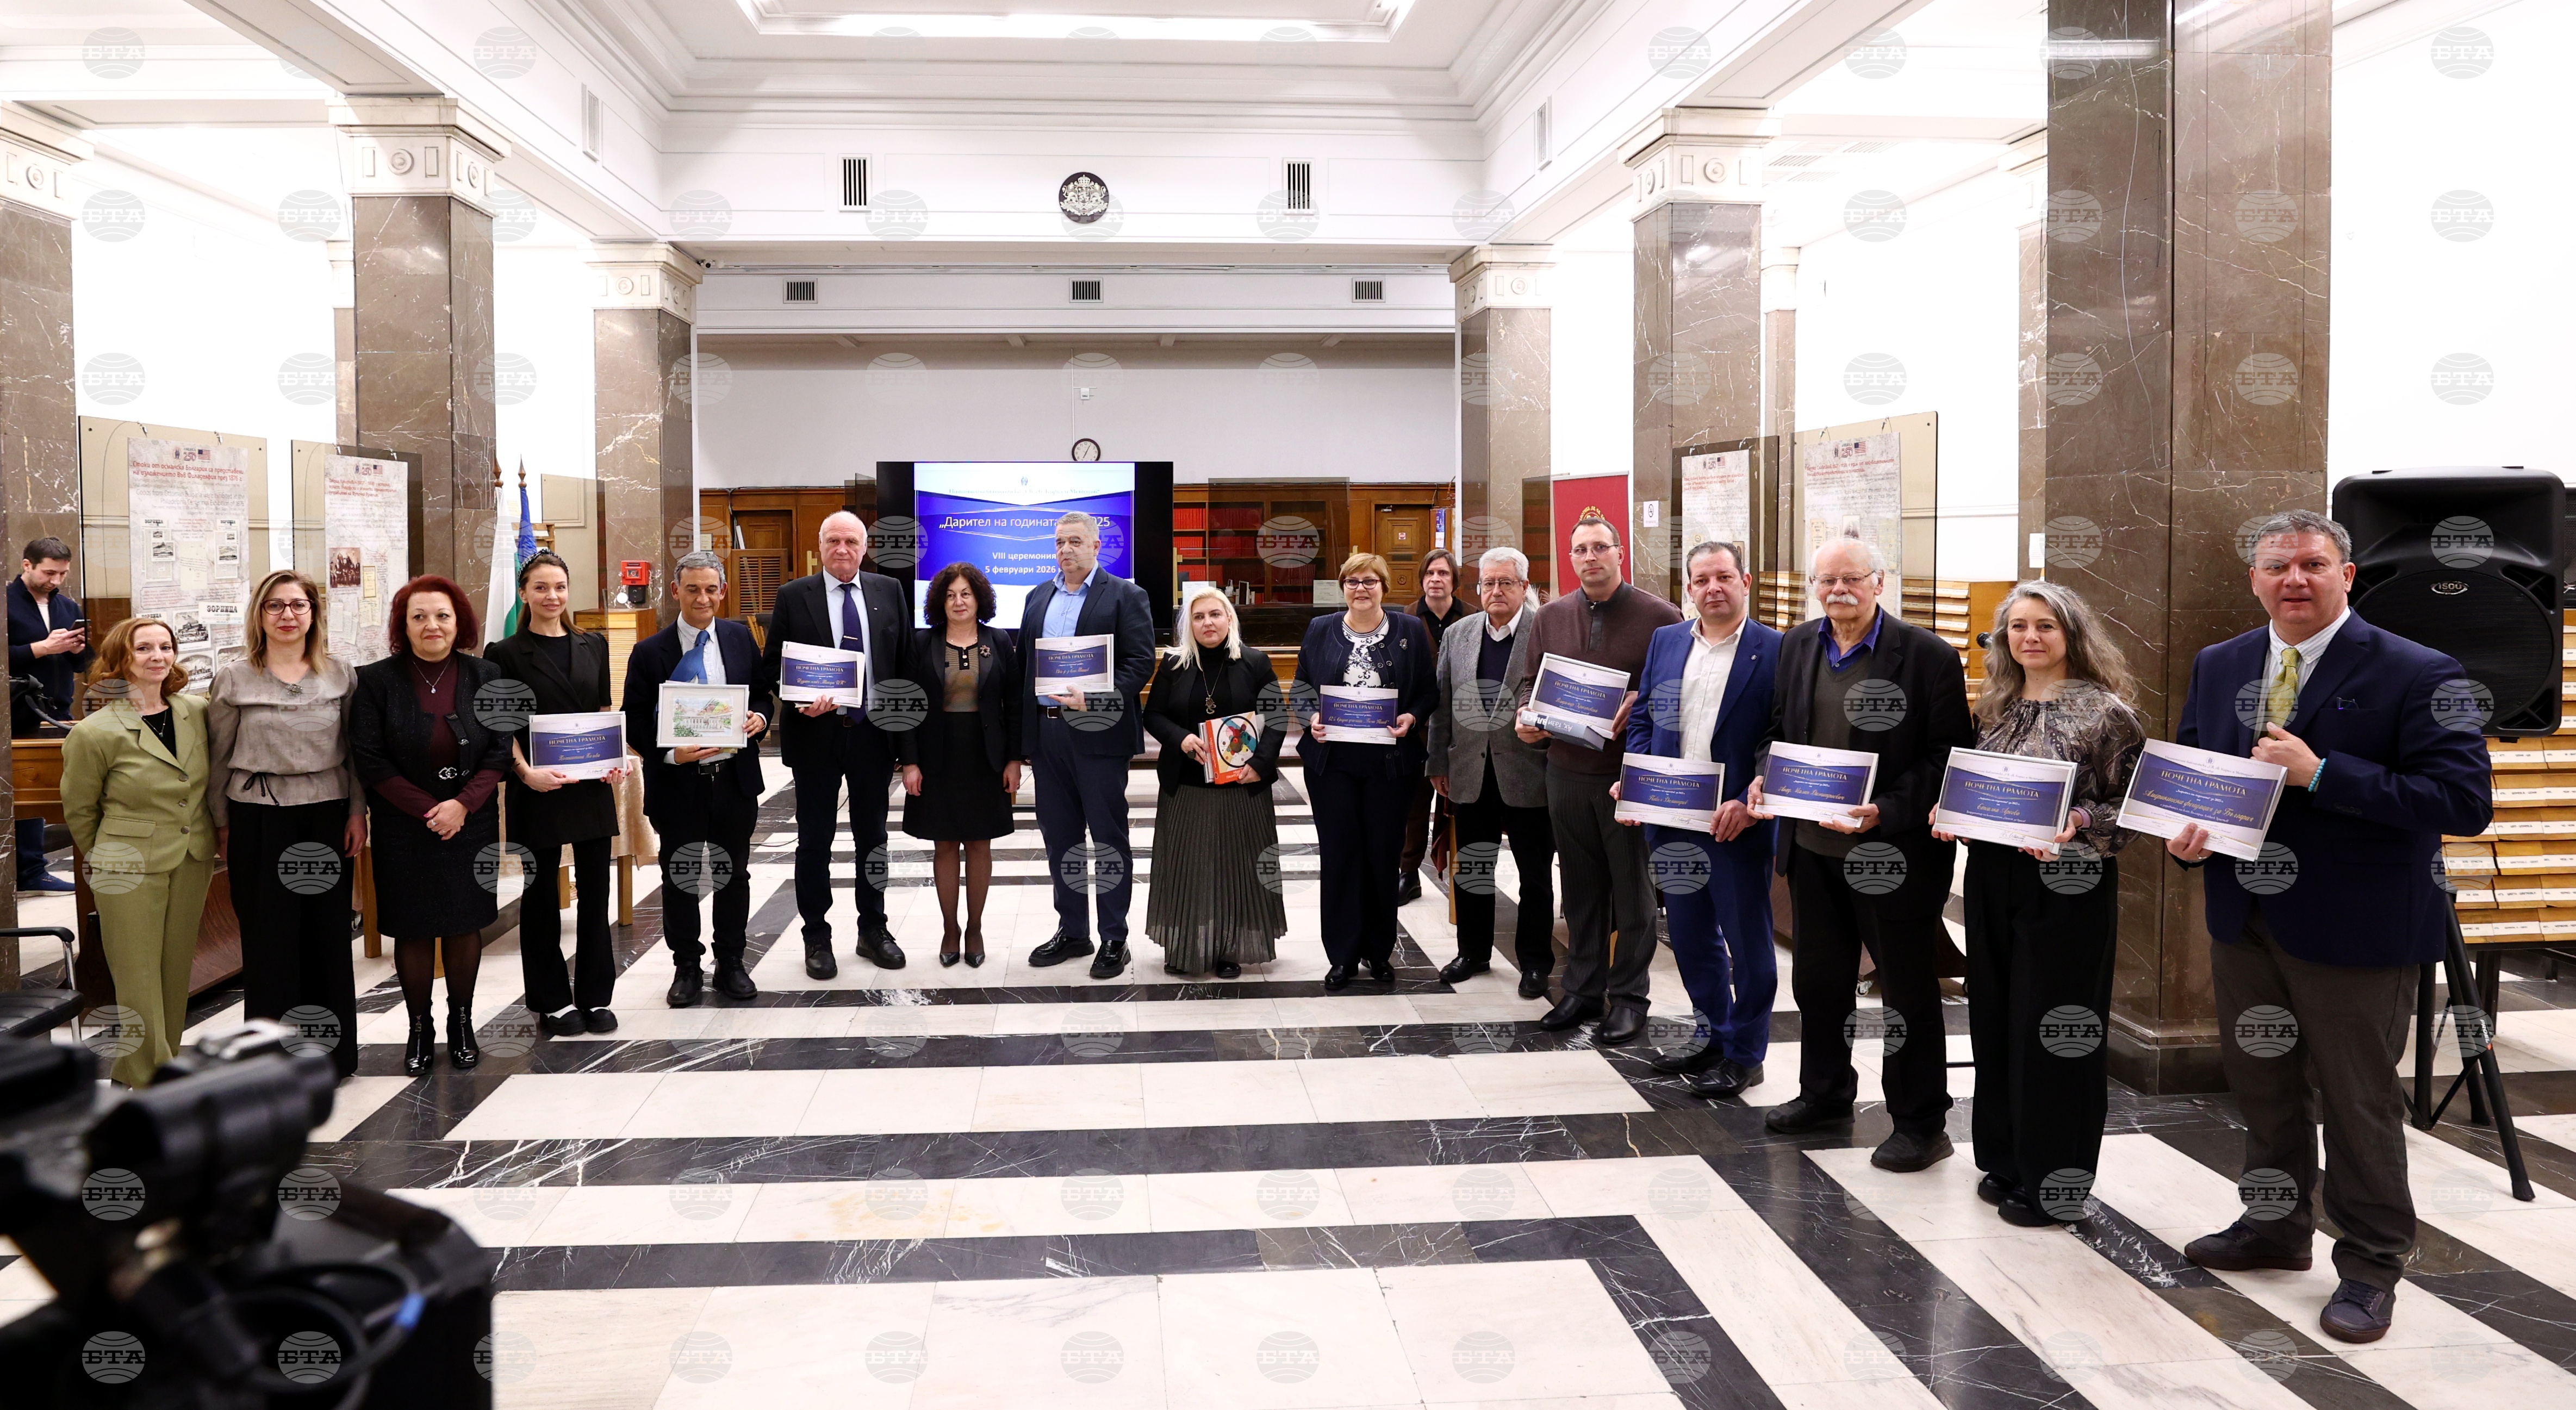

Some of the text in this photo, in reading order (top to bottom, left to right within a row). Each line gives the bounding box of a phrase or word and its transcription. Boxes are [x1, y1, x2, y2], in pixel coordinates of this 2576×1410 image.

[184, 452, 196, 461] 250
[939, 516, 991, 529] „Дарител
[992, 552, 1056, 561] VIII церемония
[992, 565, 1034, 576] февруари
[1554, 681, 1606, 698] ПОЧЕТНА ГРАМОТА
[1524, 714, 1548, 726] ВЛАСТ
[1564, 723, 1573, 732] Ах,
[1783, 766, 1847, 781] ПОЧЕТНА ГРАМОТА
[1670, 779, 1700, 788] ГРАМОТА
[2161, 770, 2246, 796] ПОЧЕТНА ГРАМОТА
[1965, 781, 2039, 798] ПОЧЕТНА ГРАМОТА
